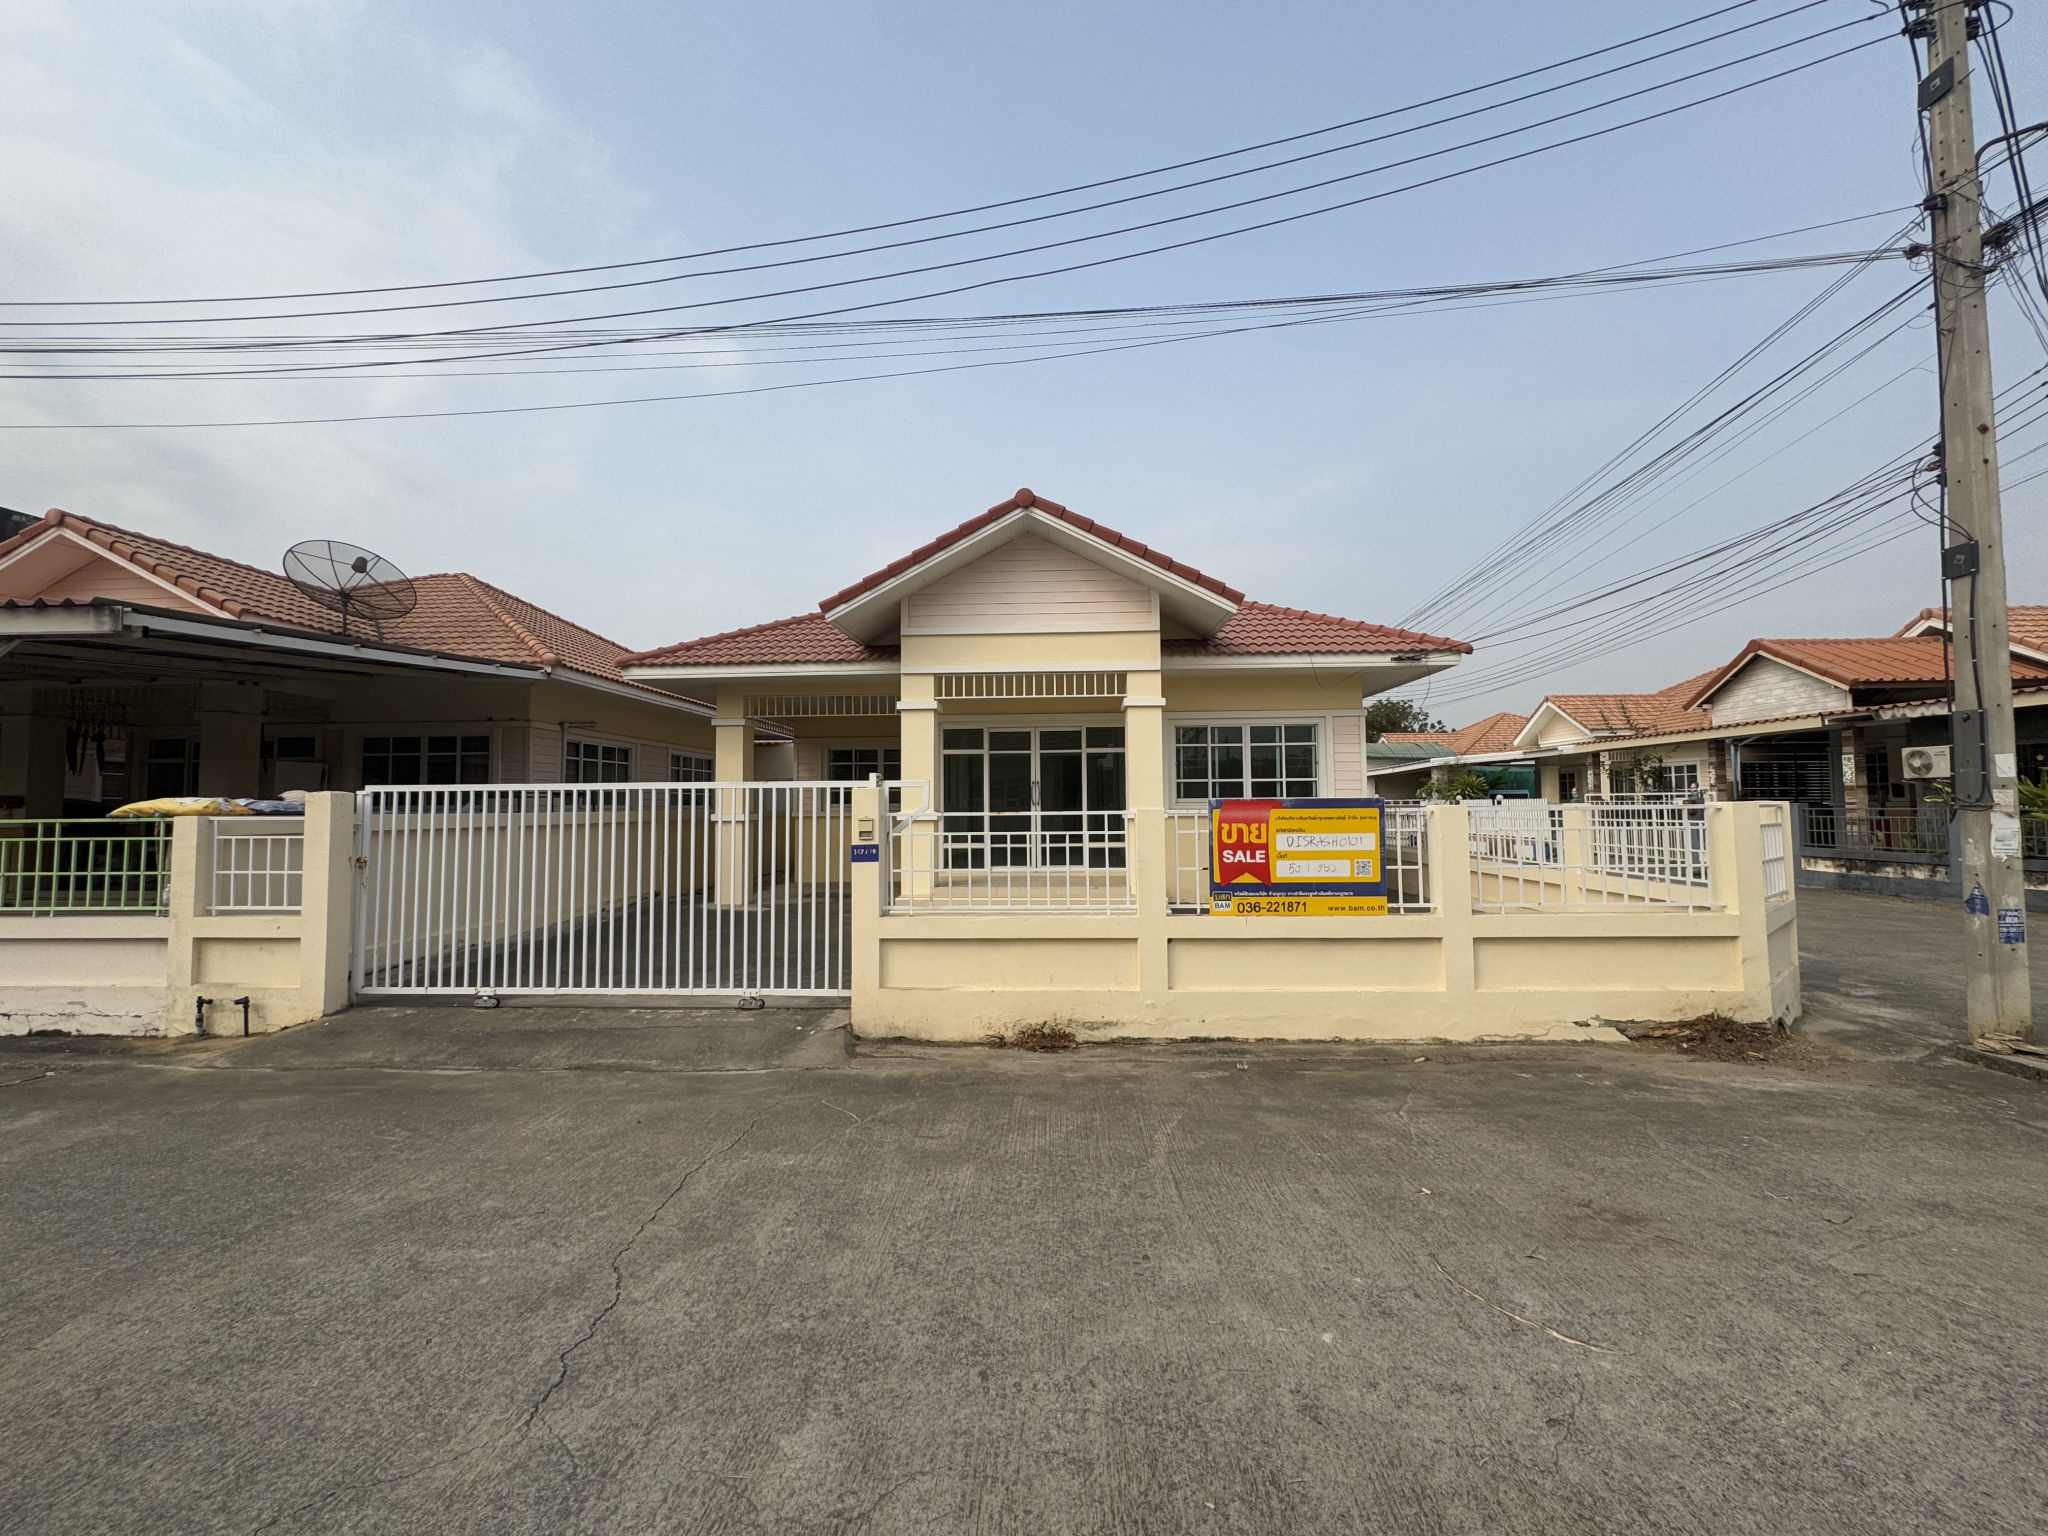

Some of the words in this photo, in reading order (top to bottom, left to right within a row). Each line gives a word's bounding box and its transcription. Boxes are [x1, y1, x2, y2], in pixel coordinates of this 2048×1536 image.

[1221, 822, 1267, 844] ขาย
[1222, 849, 1266, 863] SALE
[1237, 901, 1307, 913] 036-221871
[1327, 904, 1386, 912] www.bam.co.th
